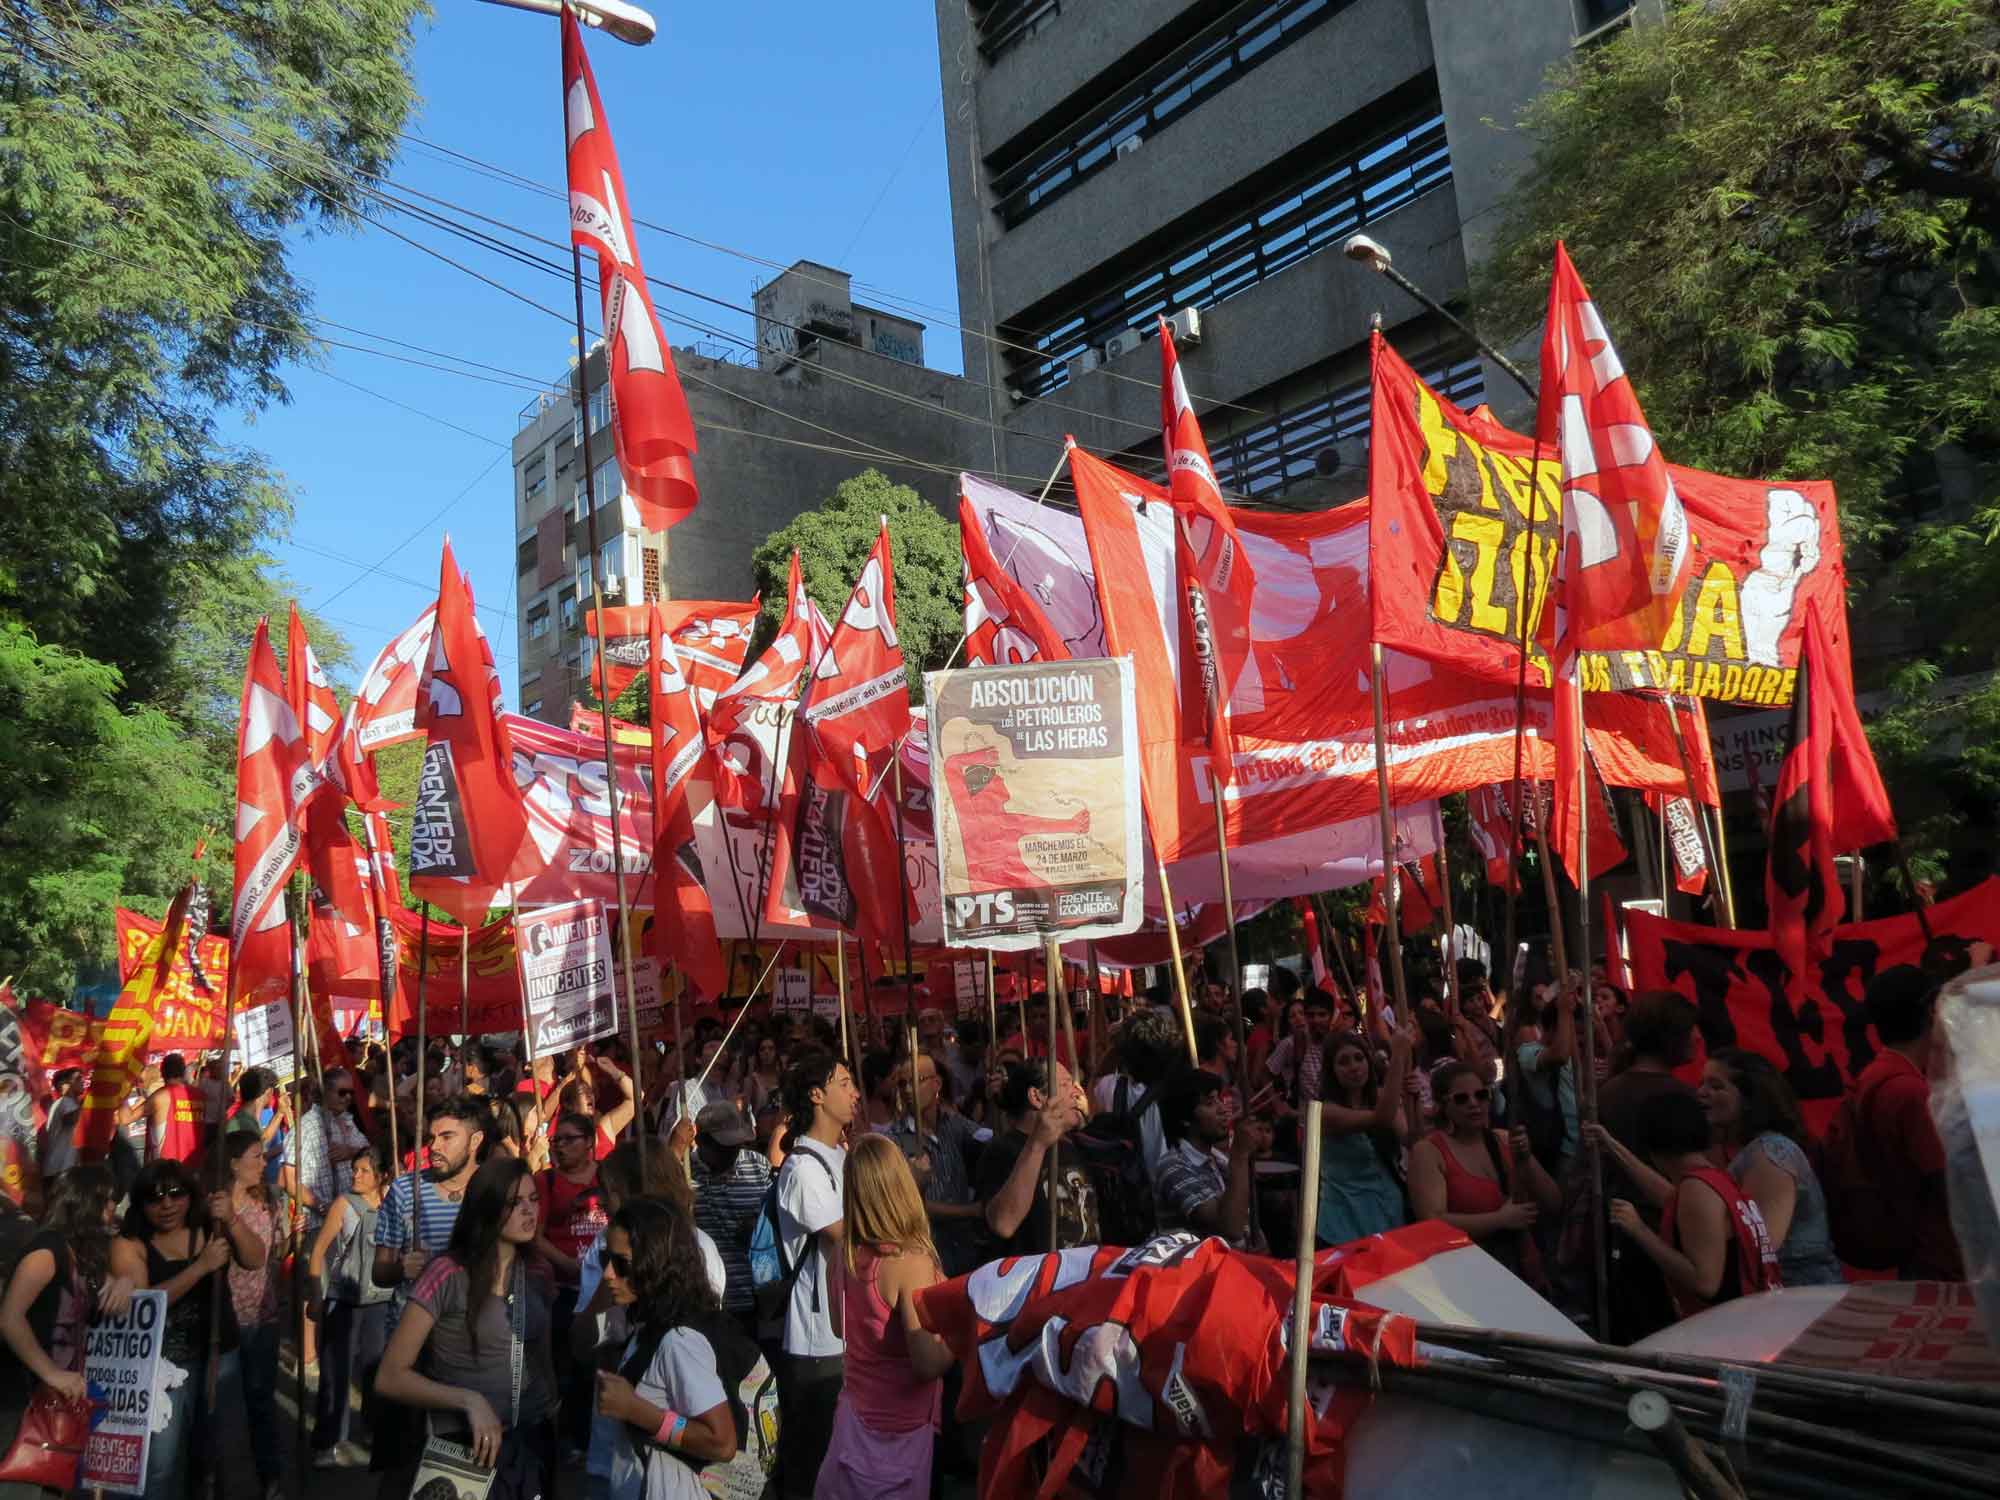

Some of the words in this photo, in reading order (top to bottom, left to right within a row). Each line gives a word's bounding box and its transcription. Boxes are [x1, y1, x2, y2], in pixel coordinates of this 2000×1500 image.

[970, 671, 1094, 708] ABSOLUCIÓN
[1016, 704, 1102, 727] PETROLEROS
[1025, 730, 1054, 751] LAS
[1058, 727, 1108, 749] HERAS
[1024, 840, 1075, 852] MARCHEMOS
[1076, 839, 1086, 849] EL
[568, 847, 653, 873] ZONA
[1036, 855, 1047, 865] 24
[1048, 854, 1059, 864] DE
[1060, 851, 1088, 863] MARZO
[955, 891, 1015, 928] PTS
[1059, 891, 1103, 904] FRENTE
[1059, 902, 1119, 917] IZQUIERDA
[551, 917, 603, 946] MIENTE
[530, 961, 606, 998] INOCENTES
[85, 1332, 152, 1359] CASTIGO
[86, 1367, 116, 1384] TODOS
[118, 1370, 138, 1385] LOS
